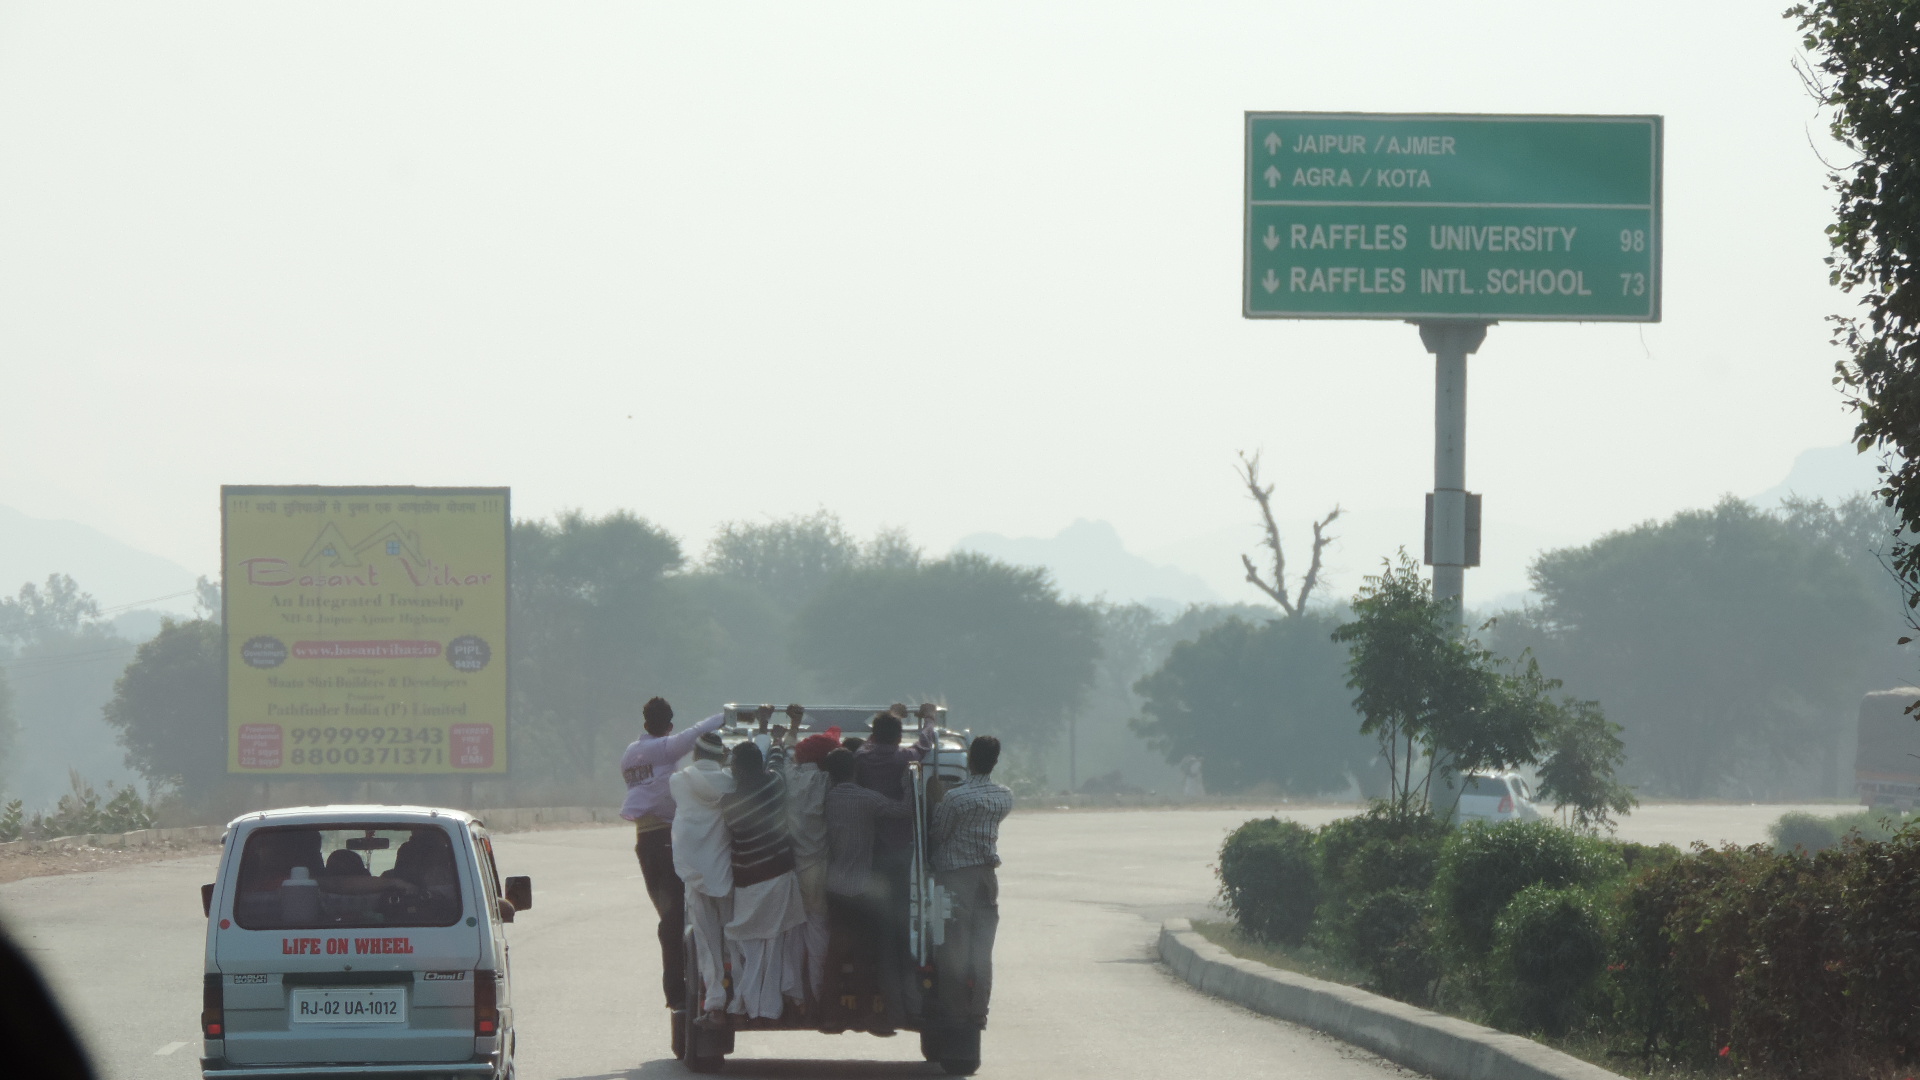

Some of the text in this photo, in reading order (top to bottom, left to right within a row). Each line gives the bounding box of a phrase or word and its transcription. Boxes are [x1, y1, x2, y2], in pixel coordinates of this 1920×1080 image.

[1293, 134, 1366, 154] JAIPUR
[1292, 168, 1353, 187] AGRA
[1377, 169, 1431, 188] KOTA
[1291, 224, 1645, 252] RAFFLES UNIVERSITY 98
[1290, 267, 1406, 293] RAFFLES
[1620, 272, 1645, 296] 73
[238, 556, 493, 587] Basant Vihar
[271, 592, 464, 611] An Integrated Township
[400, 612, 451, 627] Highway
[295, 643, 437, 657] www.basantvihar.in
[454, 645, 483, 655] PIPL
[336, 676, 385, 688] Builders
[388, 676, 398, 688] &
[403, 676, 467, 691] Developers
[268, 702, 340, 716] Pathfinder
[345, 702, 380, 716] India
[412, 702, 467, 716] Limited
[290, 726, 443, 744] 9999992343
[290, 747, 443, 765] 8800371371
[282, 937, 413, 955] LIFE ON WHEEL
[425, 972, 456, 980] Omni
[300, 1000, 397, 1015] RJ-02 UA-1012
